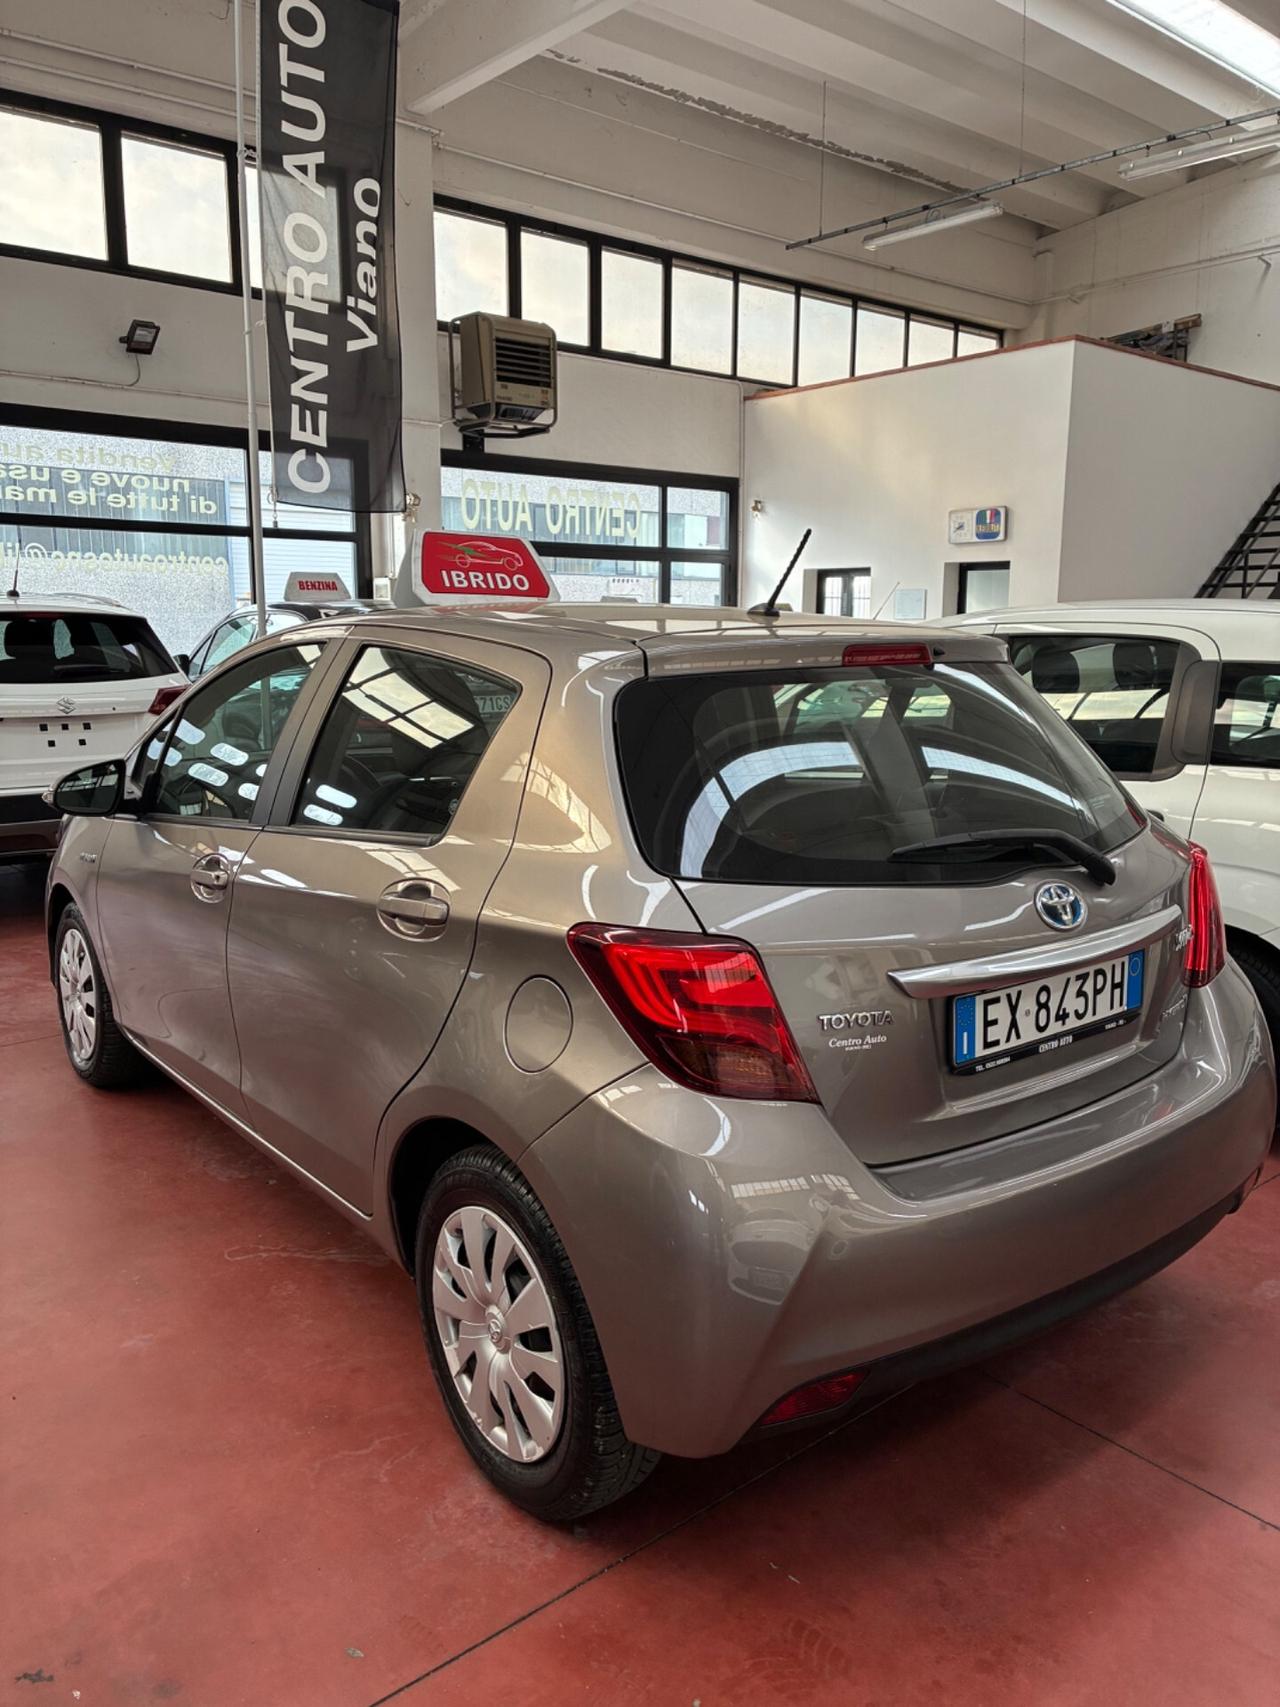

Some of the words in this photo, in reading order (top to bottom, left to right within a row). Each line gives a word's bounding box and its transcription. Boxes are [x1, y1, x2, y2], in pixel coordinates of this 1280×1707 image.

[277, 0, 327, 200] AUTO
[346, 176, 382, 353] Viano
[283, 210, 331, 494] CENTRO
[298, 579, 338, 592] BENZINA
[439, 569, 530, 591] IBRIDO
[818, 1010, 895, 1031] TOYOTA
[982, 989, 1024, 1049] EX
[1035, 962, 1126, 1034] 843PH
[828, 1038, 862, 1048] Centro
[863, 1033, 887, 1045] Auto
